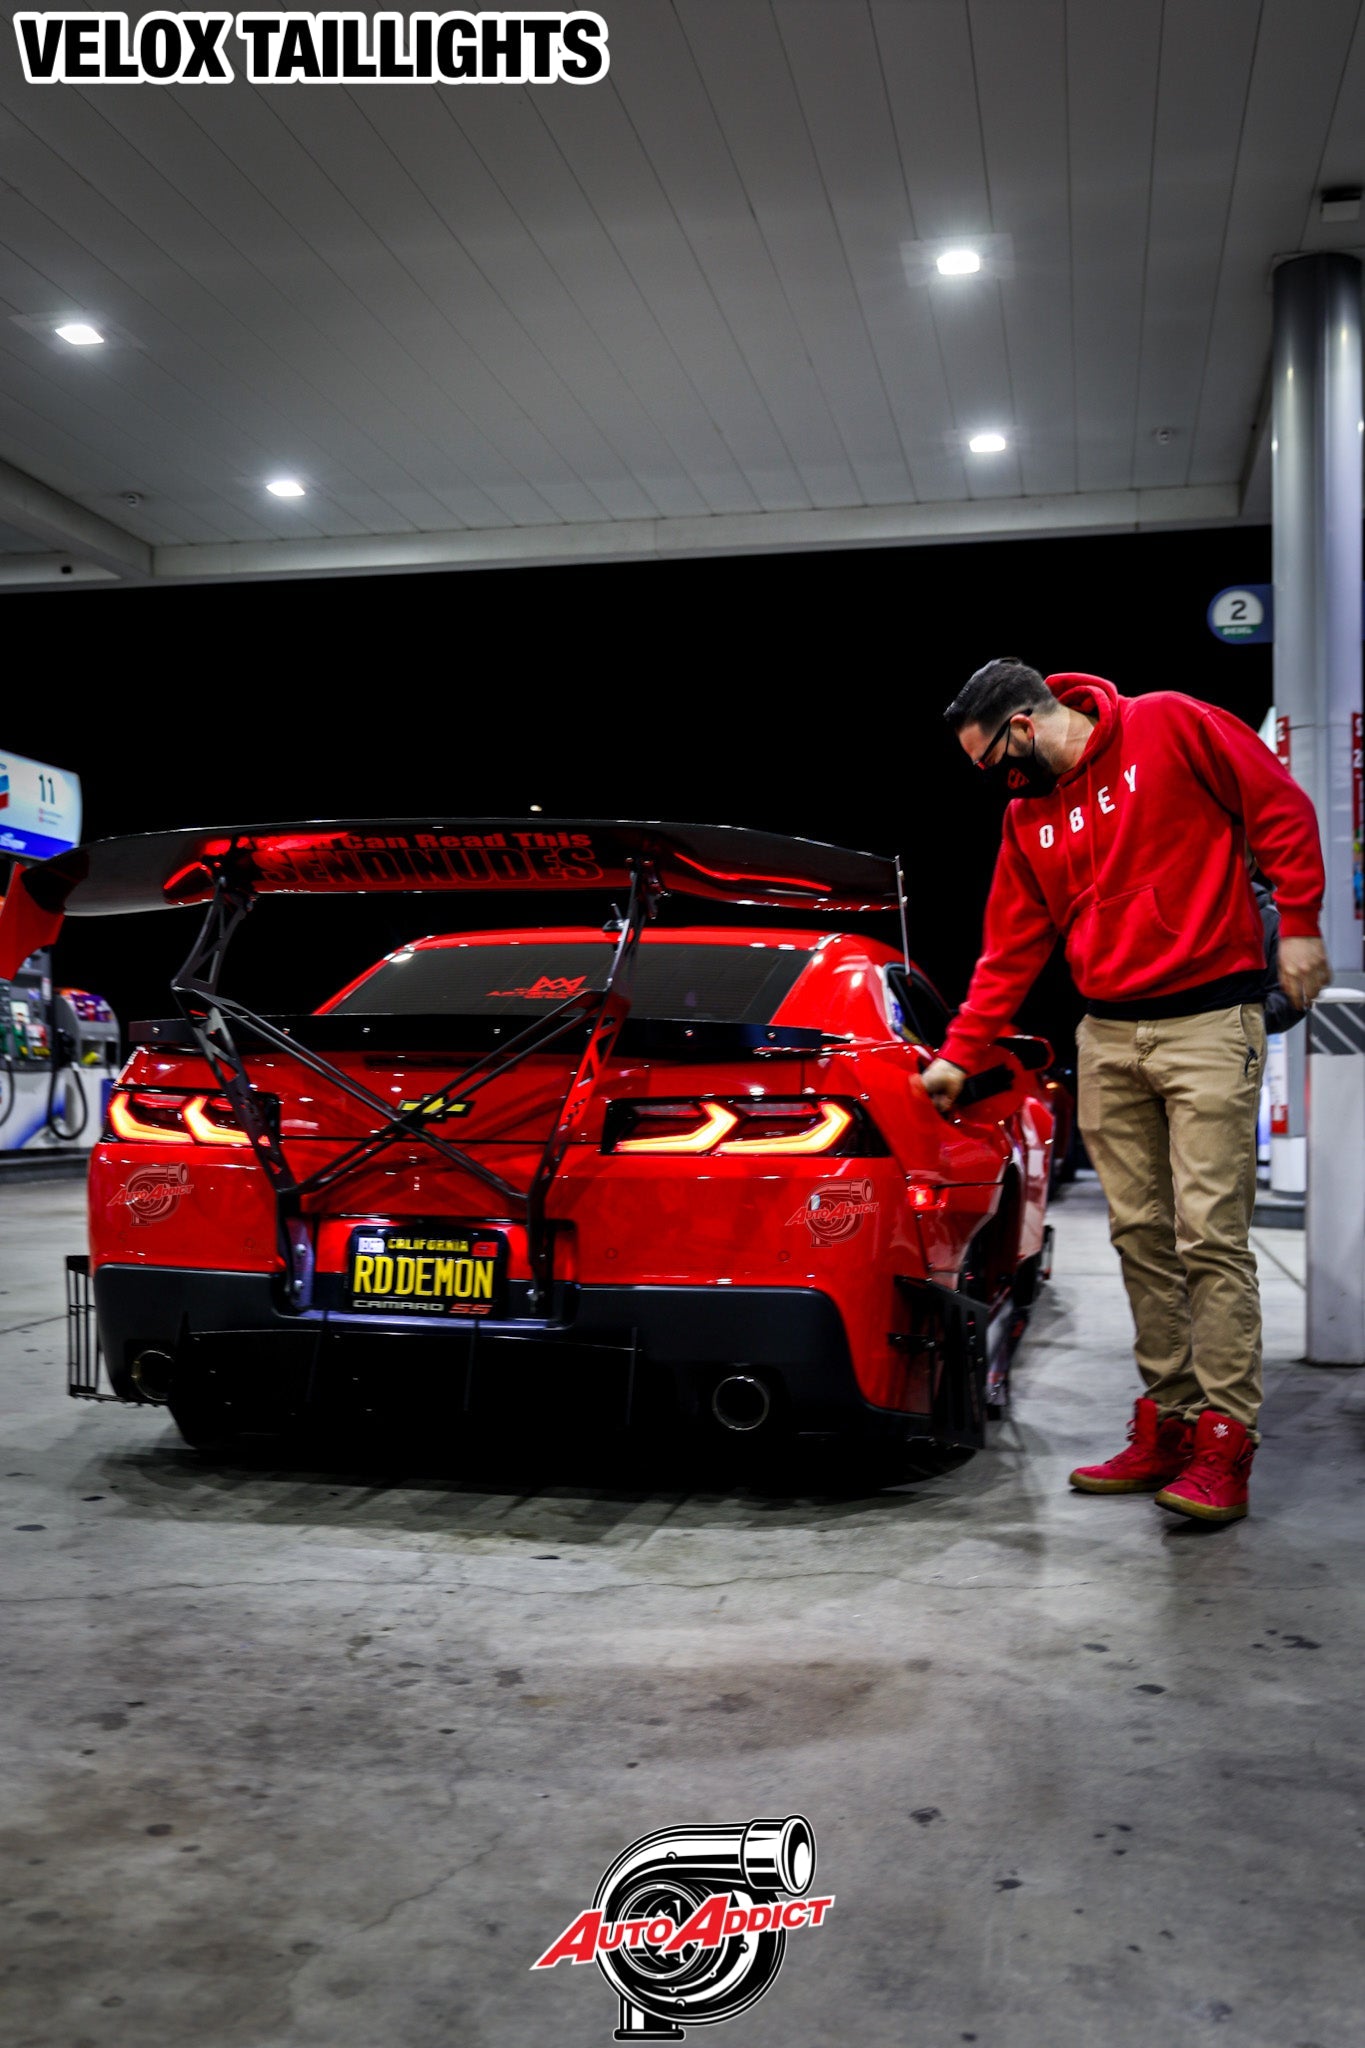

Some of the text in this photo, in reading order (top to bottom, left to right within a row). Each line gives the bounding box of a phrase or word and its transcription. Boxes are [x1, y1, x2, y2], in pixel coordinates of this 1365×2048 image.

[1231, 600, 1247, 620] 2
[39, 774, 55, 805] 11
[1039, 764, 1137, 849] OBEY
[413, 832, 507, 849] Read
[511, 831, 592, 847] This
[256, 846, 604, 884] SEND NUDES
[387, 1238, 469, 1252] CALIFORNIA
[353, 1300, 493, 1315] CAMARO SS
